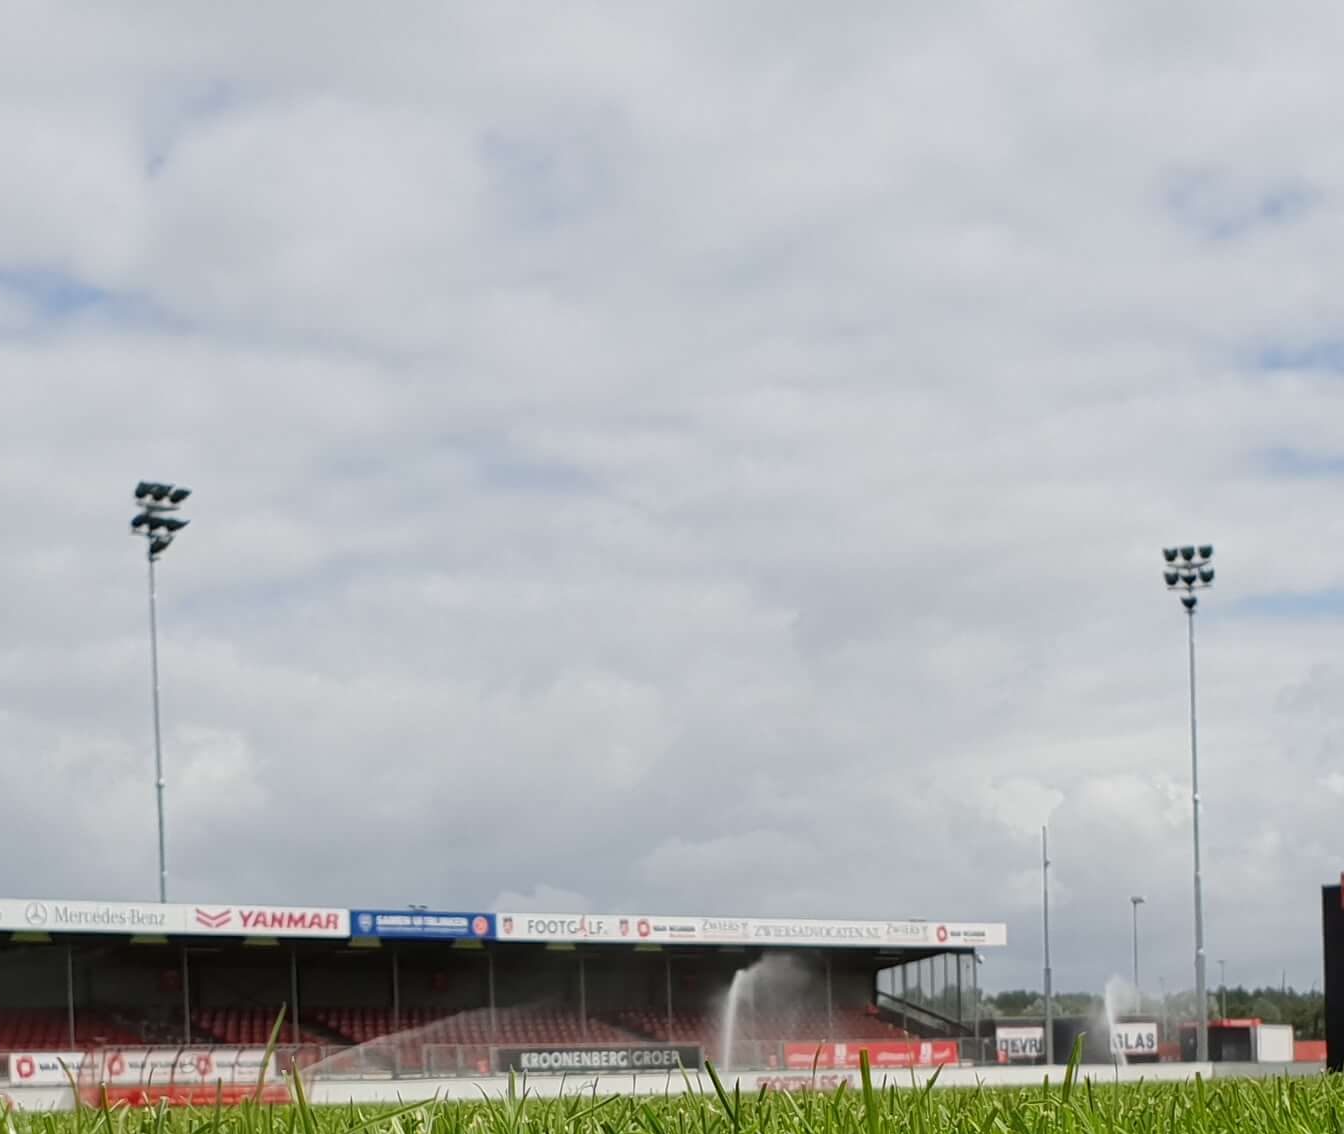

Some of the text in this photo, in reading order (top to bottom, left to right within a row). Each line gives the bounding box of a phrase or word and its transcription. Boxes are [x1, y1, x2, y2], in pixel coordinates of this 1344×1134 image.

[55, 906, 167, 926] Mercedes-Benz
[240, 910, 340, 929] YANMAR
[519, 1050, 681, 1068] KROONENBERG GROEP
